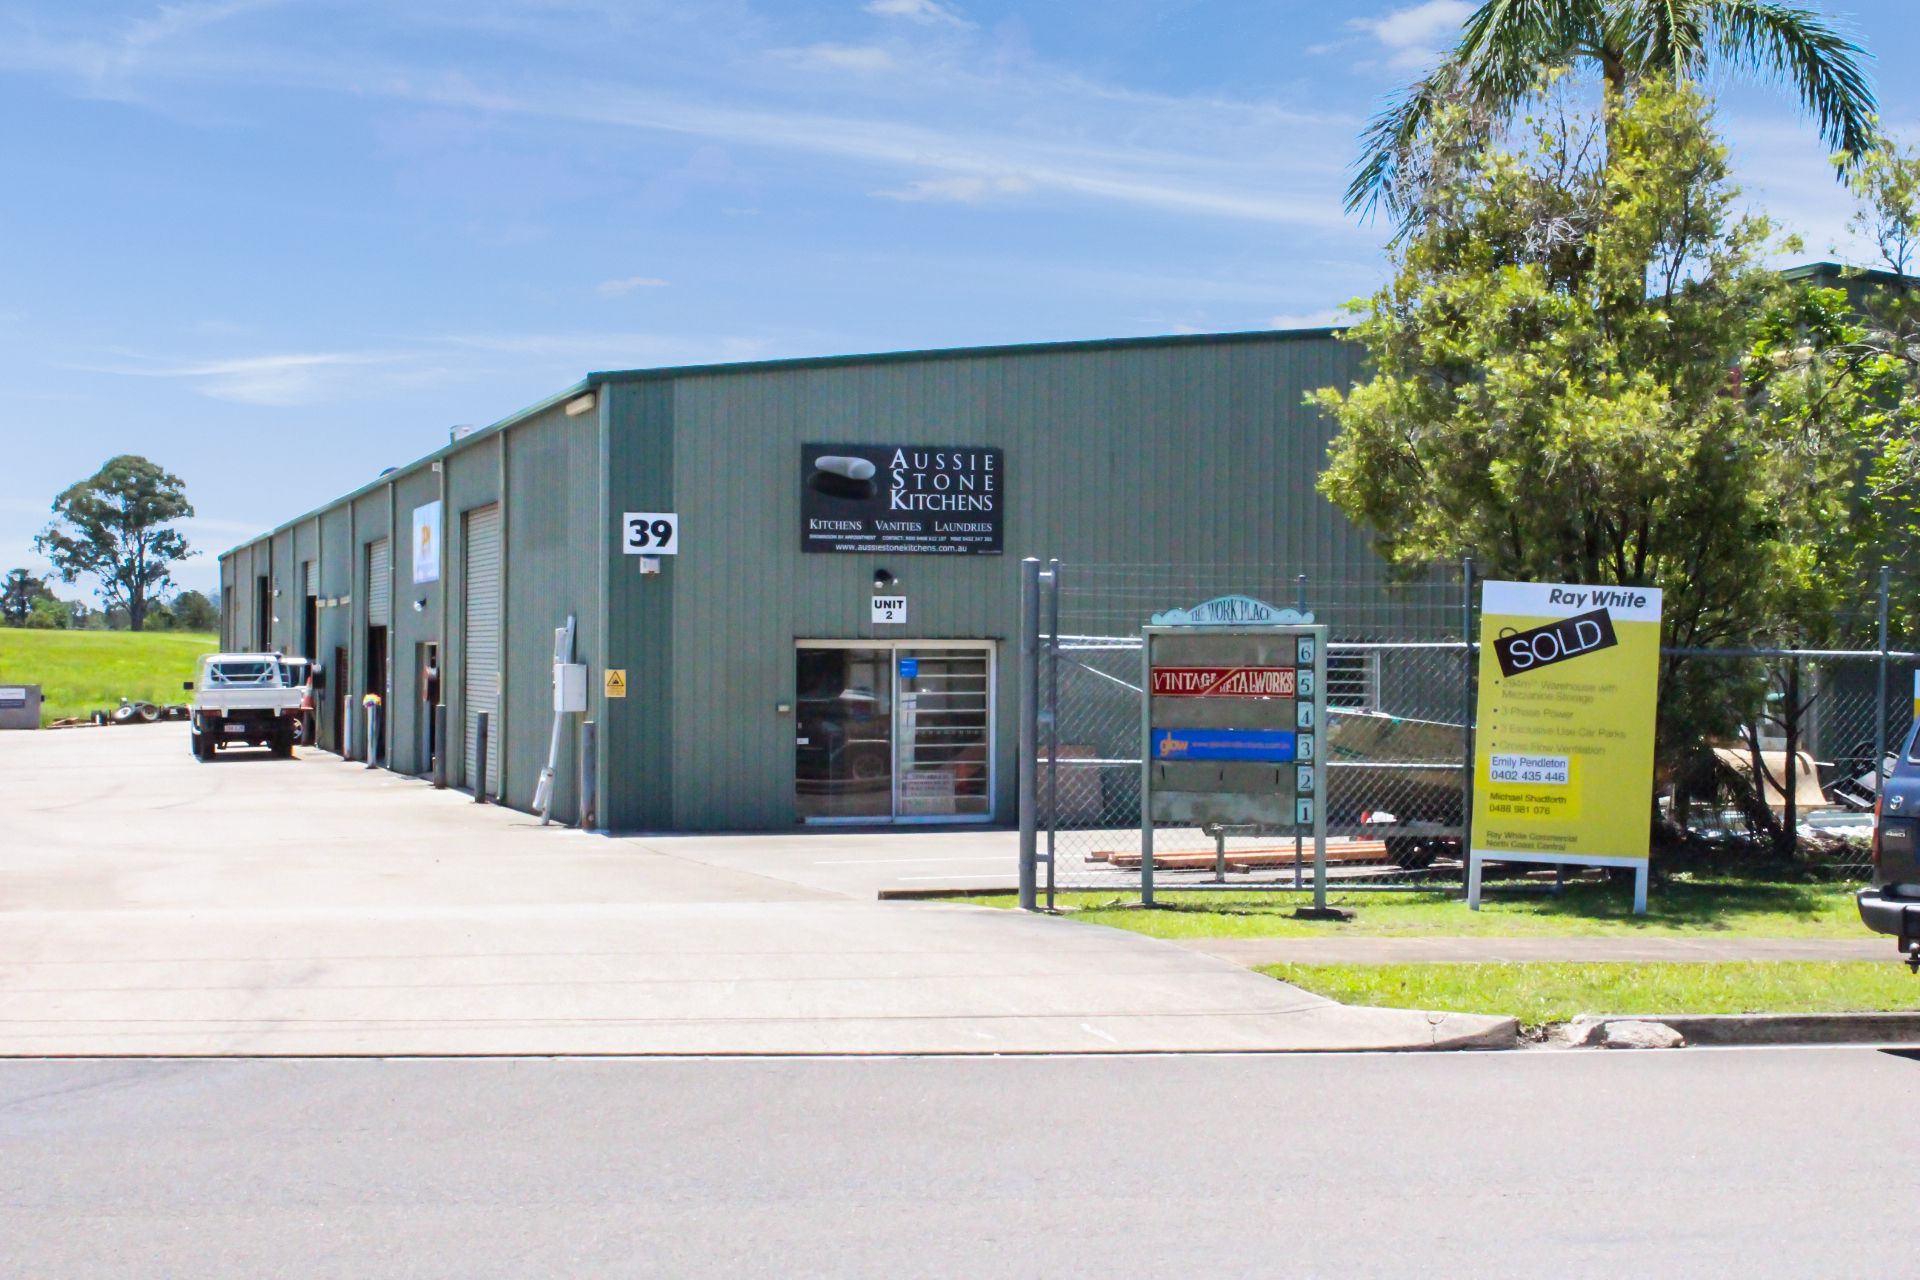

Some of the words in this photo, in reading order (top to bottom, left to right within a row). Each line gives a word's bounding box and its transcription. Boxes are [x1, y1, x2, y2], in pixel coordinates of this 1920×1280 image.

[889, 448, 994, 470] AUSSIE
[892, 469, 994, 491] STONE
[889, 489, 993, 512] KITCHENS
[810, 518, 862, 530] KITCHENS
[875, 520, 922, 531] VANITIES
[935, 521, 993, 532] LAUNDRIES
[629, 519, 672, 547] 39
[836, 543, 968, 553] www.aussiestonekitchens.com.au
[874, 600, 904, 609] UNIT
[1549, 588, 1587, 608] Ray
[1592, 590, 1647, 608] White
[886, 611, 893, 619] 2
[1509, 620, 1601, 668] SOLD
[1301, 645, 1311, 661] 6
[1153, 672, 1216, 690] VINTAGE
[1301, 678, 1310, 693] 5
[1301, 710, 1310, 725] 4
[1301, 742, 1311, 757] 3
[1492, 756, 1517, 768] Emily
[1520, 757, 1566, 768] Pendleton
[1301, 774, 1311, 788] 2
[1491, 770, 1517, 781] 0402
[1521, 771, 1541, 781] 435
[1544, 772, 1566, 782] 446
[1490, 792, 1523, 802] Michael
[1303, 807, 1309, 821] 1
[1534, 806, 1551, 815] 076
